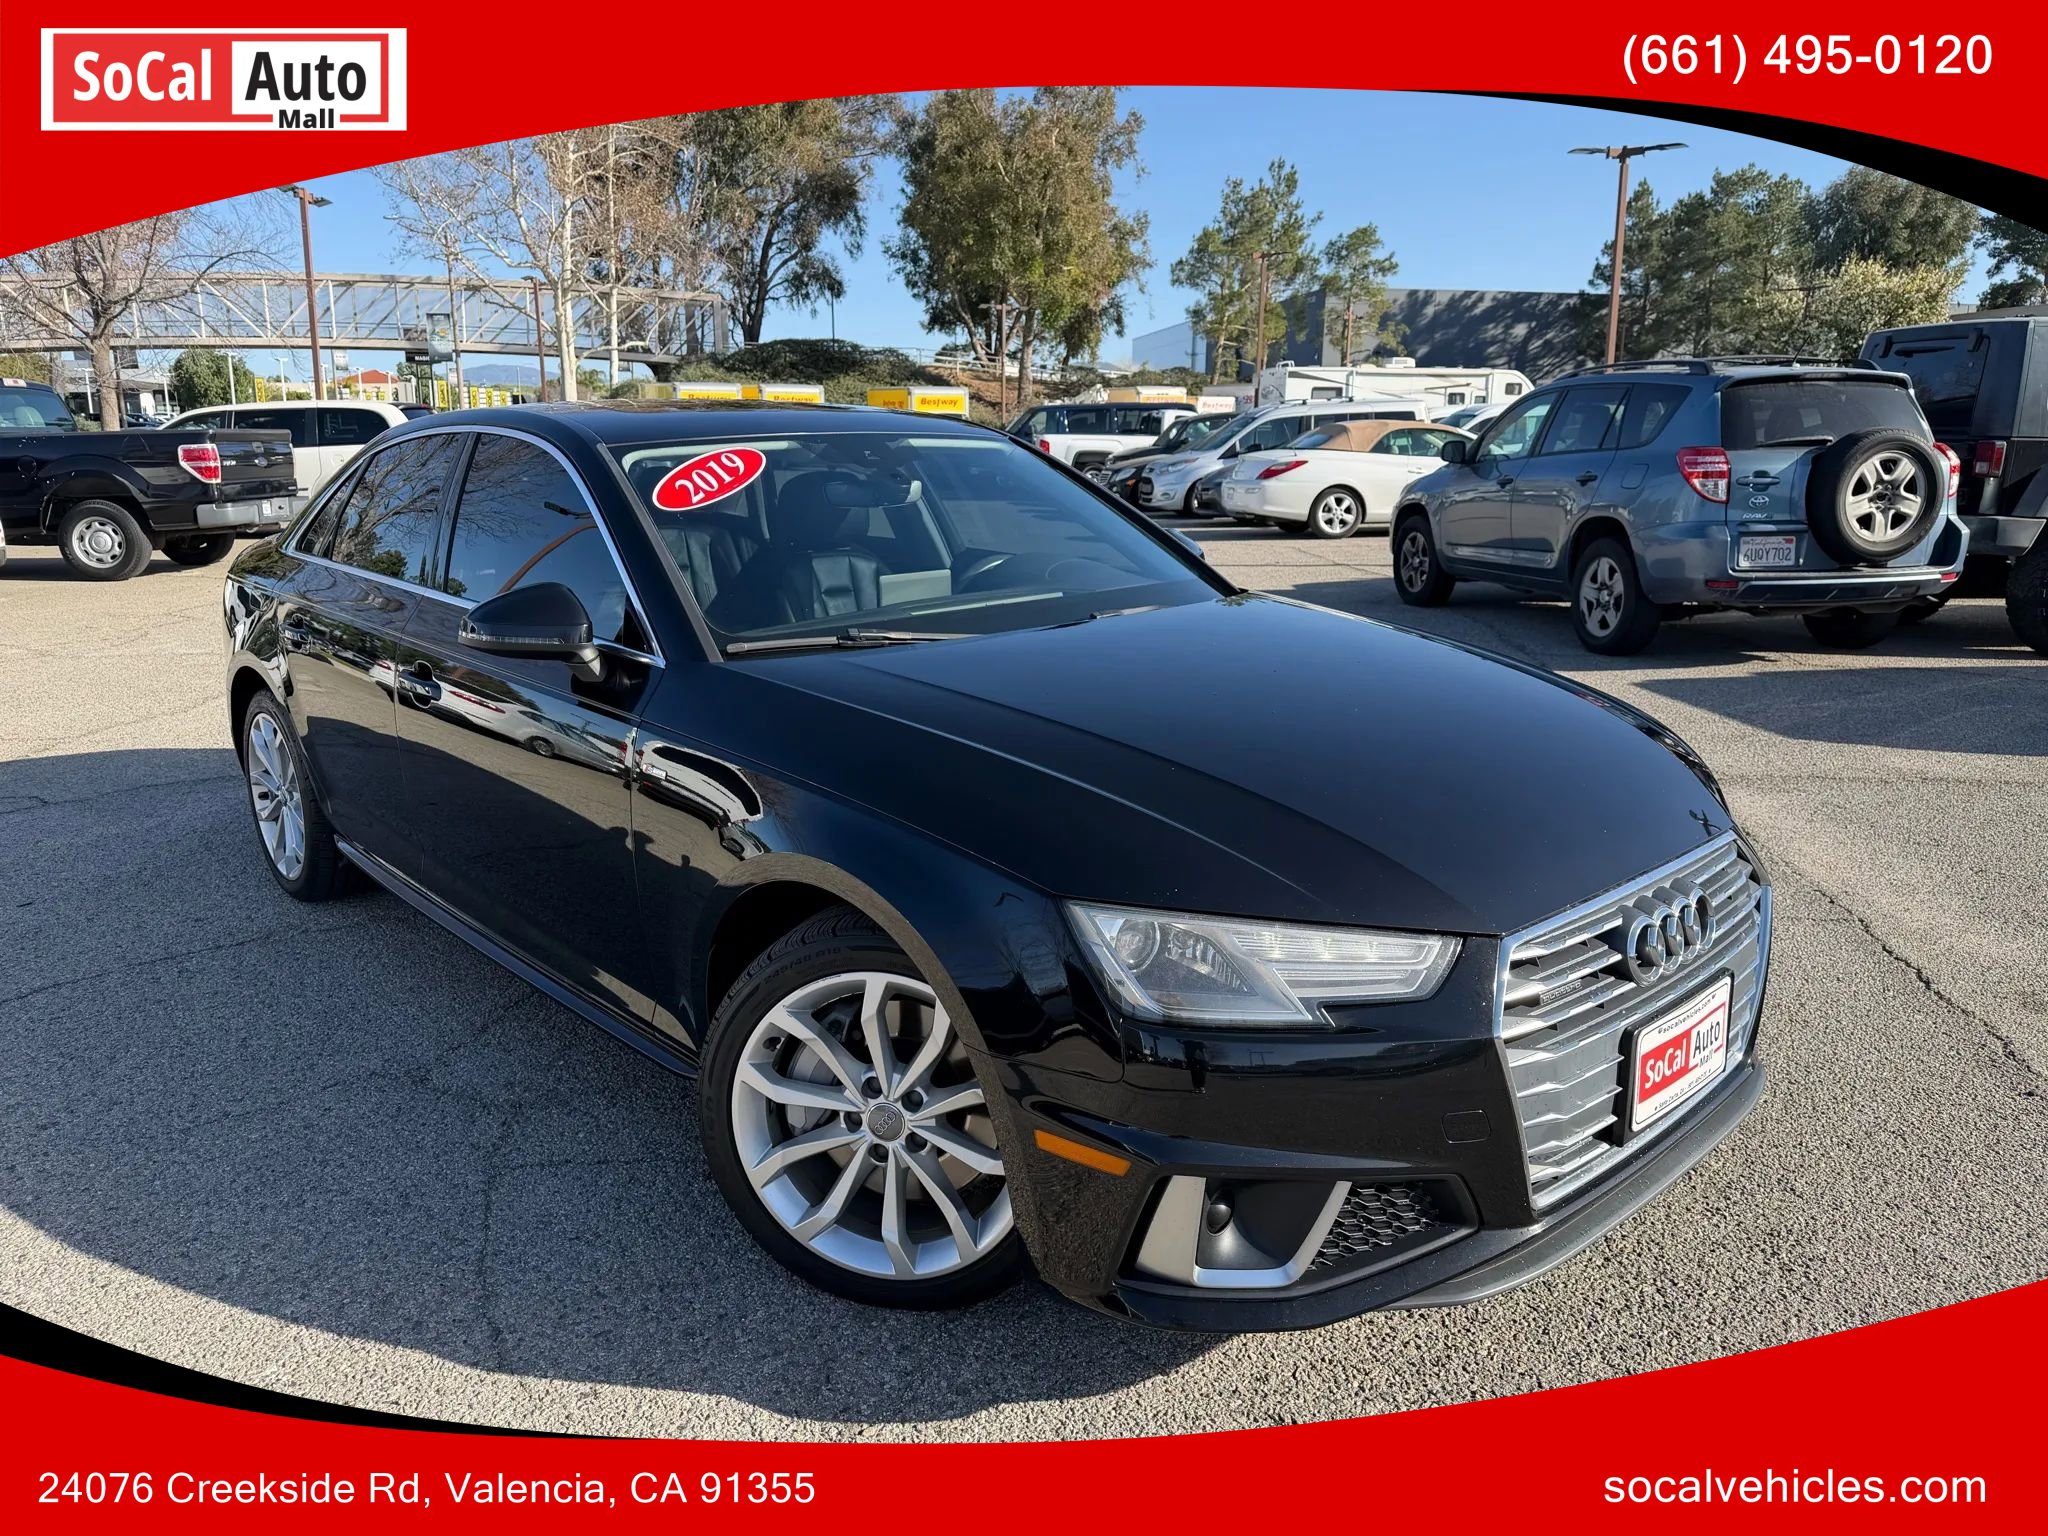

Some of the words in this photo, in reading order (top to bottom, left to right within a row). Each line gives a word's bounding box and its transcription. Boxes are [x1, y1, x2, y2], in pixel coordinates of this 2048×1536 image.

[920, 398, 958, 407] Bestway
[675, 452, 745, 504] 2019
[1644, 1038, 1687, 1089] SoCal
[1692, 1020, 1721, 1059] Auto
[1699, 1050, 1714, 1067] Mall
